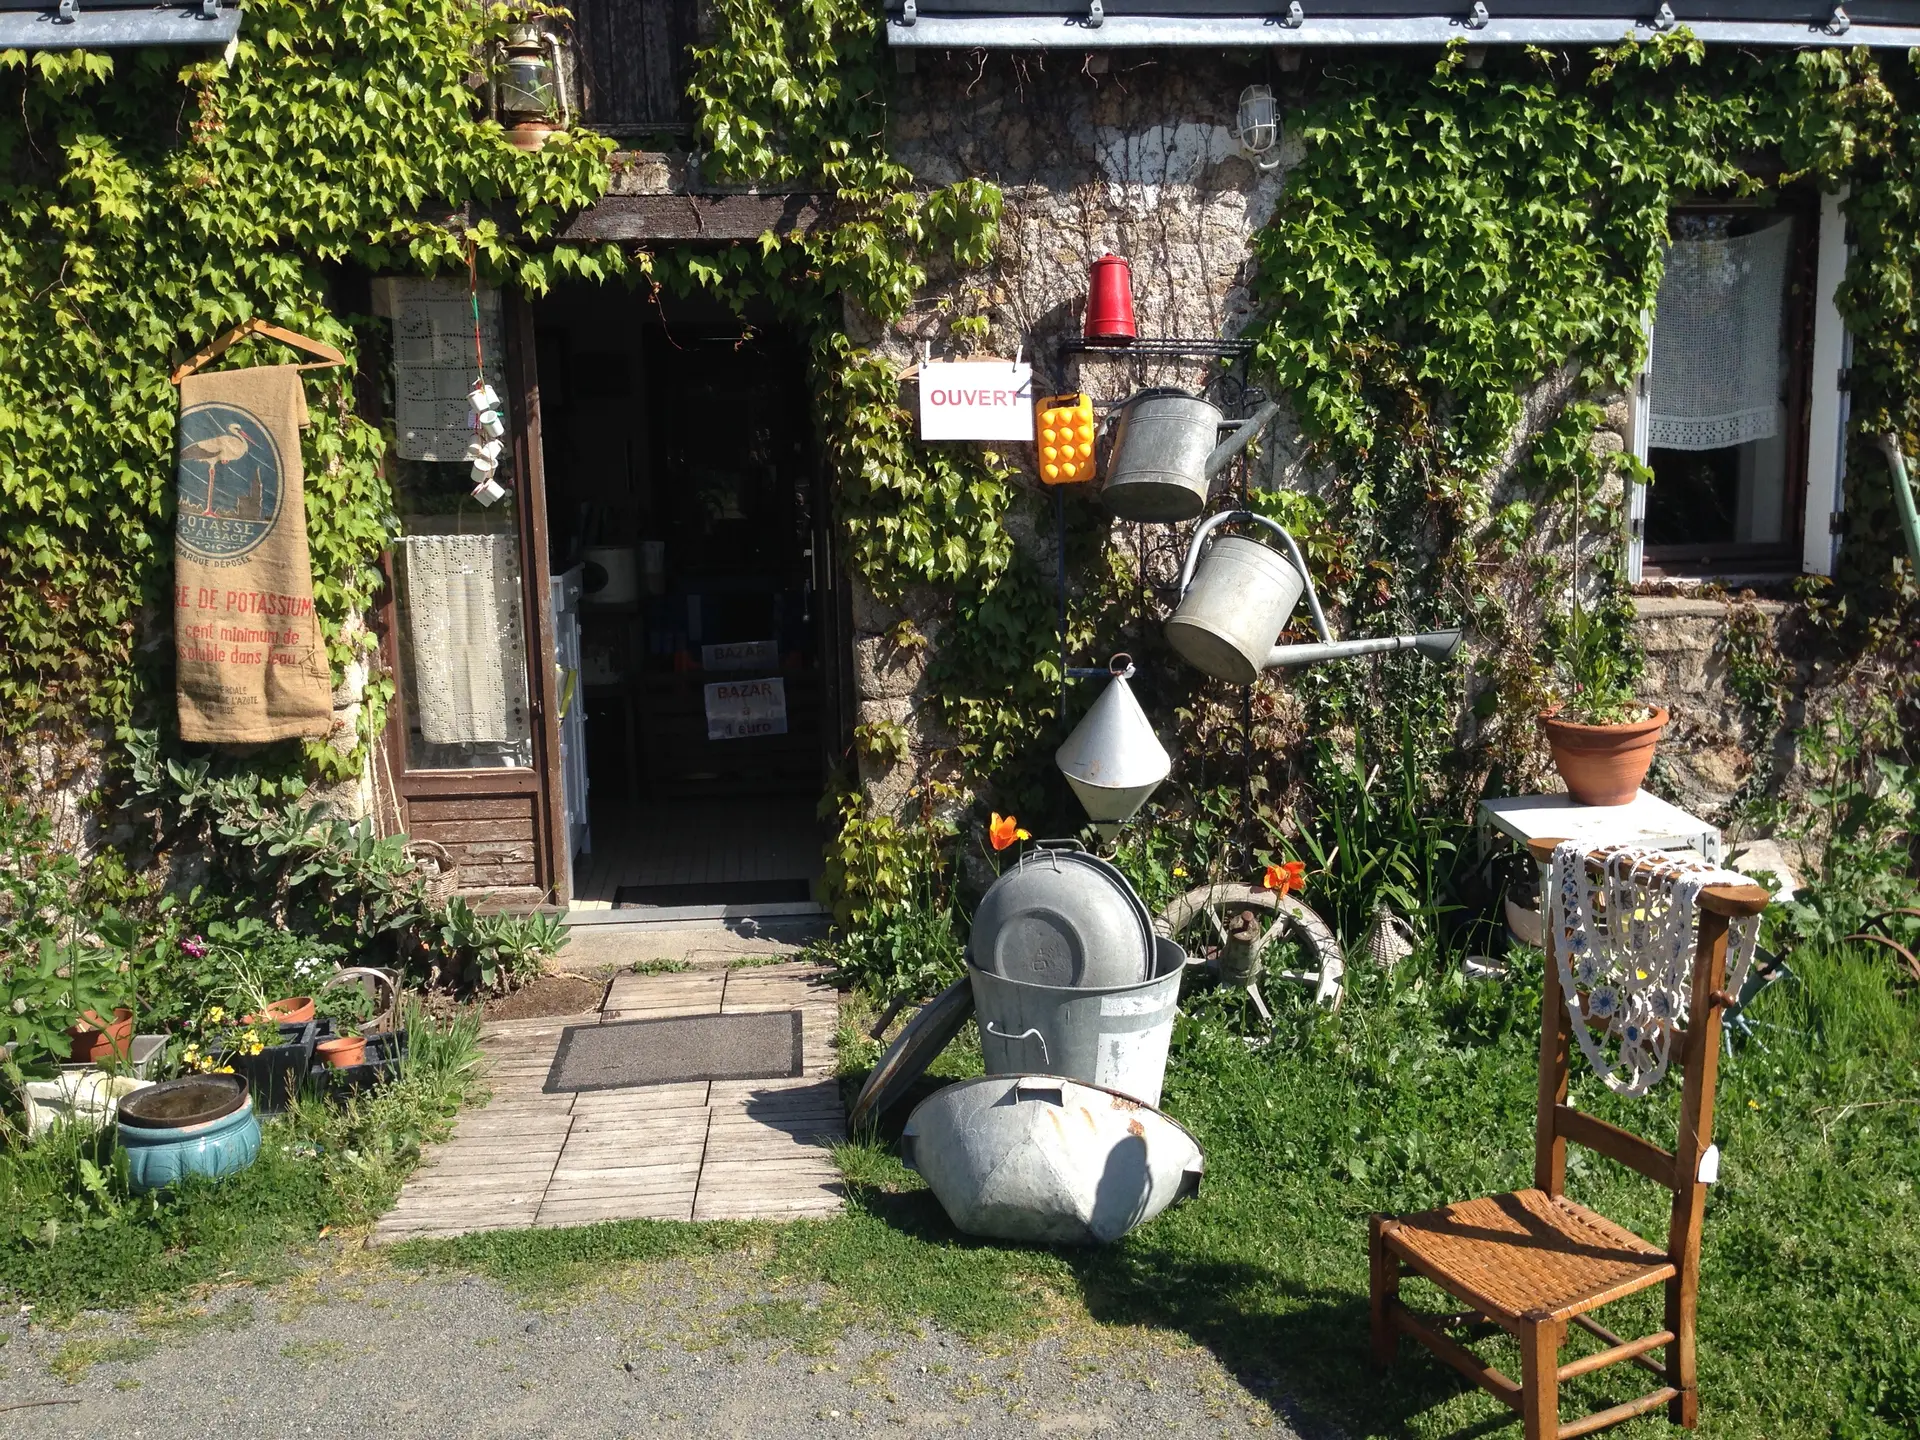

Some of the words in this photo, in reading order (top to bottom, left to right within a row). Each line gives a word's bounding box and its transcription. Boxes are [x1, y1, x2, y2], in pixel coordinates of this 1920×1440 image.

[930, 389, 1018, 406] OUVERT
[181, 526, 247, 543] D'ALSACE
[198, 588, 218, 610] DE
[226, 590, 312, 617] POTASSIUM
[185, 623, 213, 640] cent
[220, 626, 279, 644] minimum
[283, 628, 300, 645] de
[180, 643, 226, 663] soluble
[231, 645, 262, 665] dans
[715, 645, 765, 660] BAZAR
[718, 683, 772, 698] BAZAR
[726, 724, 732, 735] 1
[738, 723, 771, 735] euro
